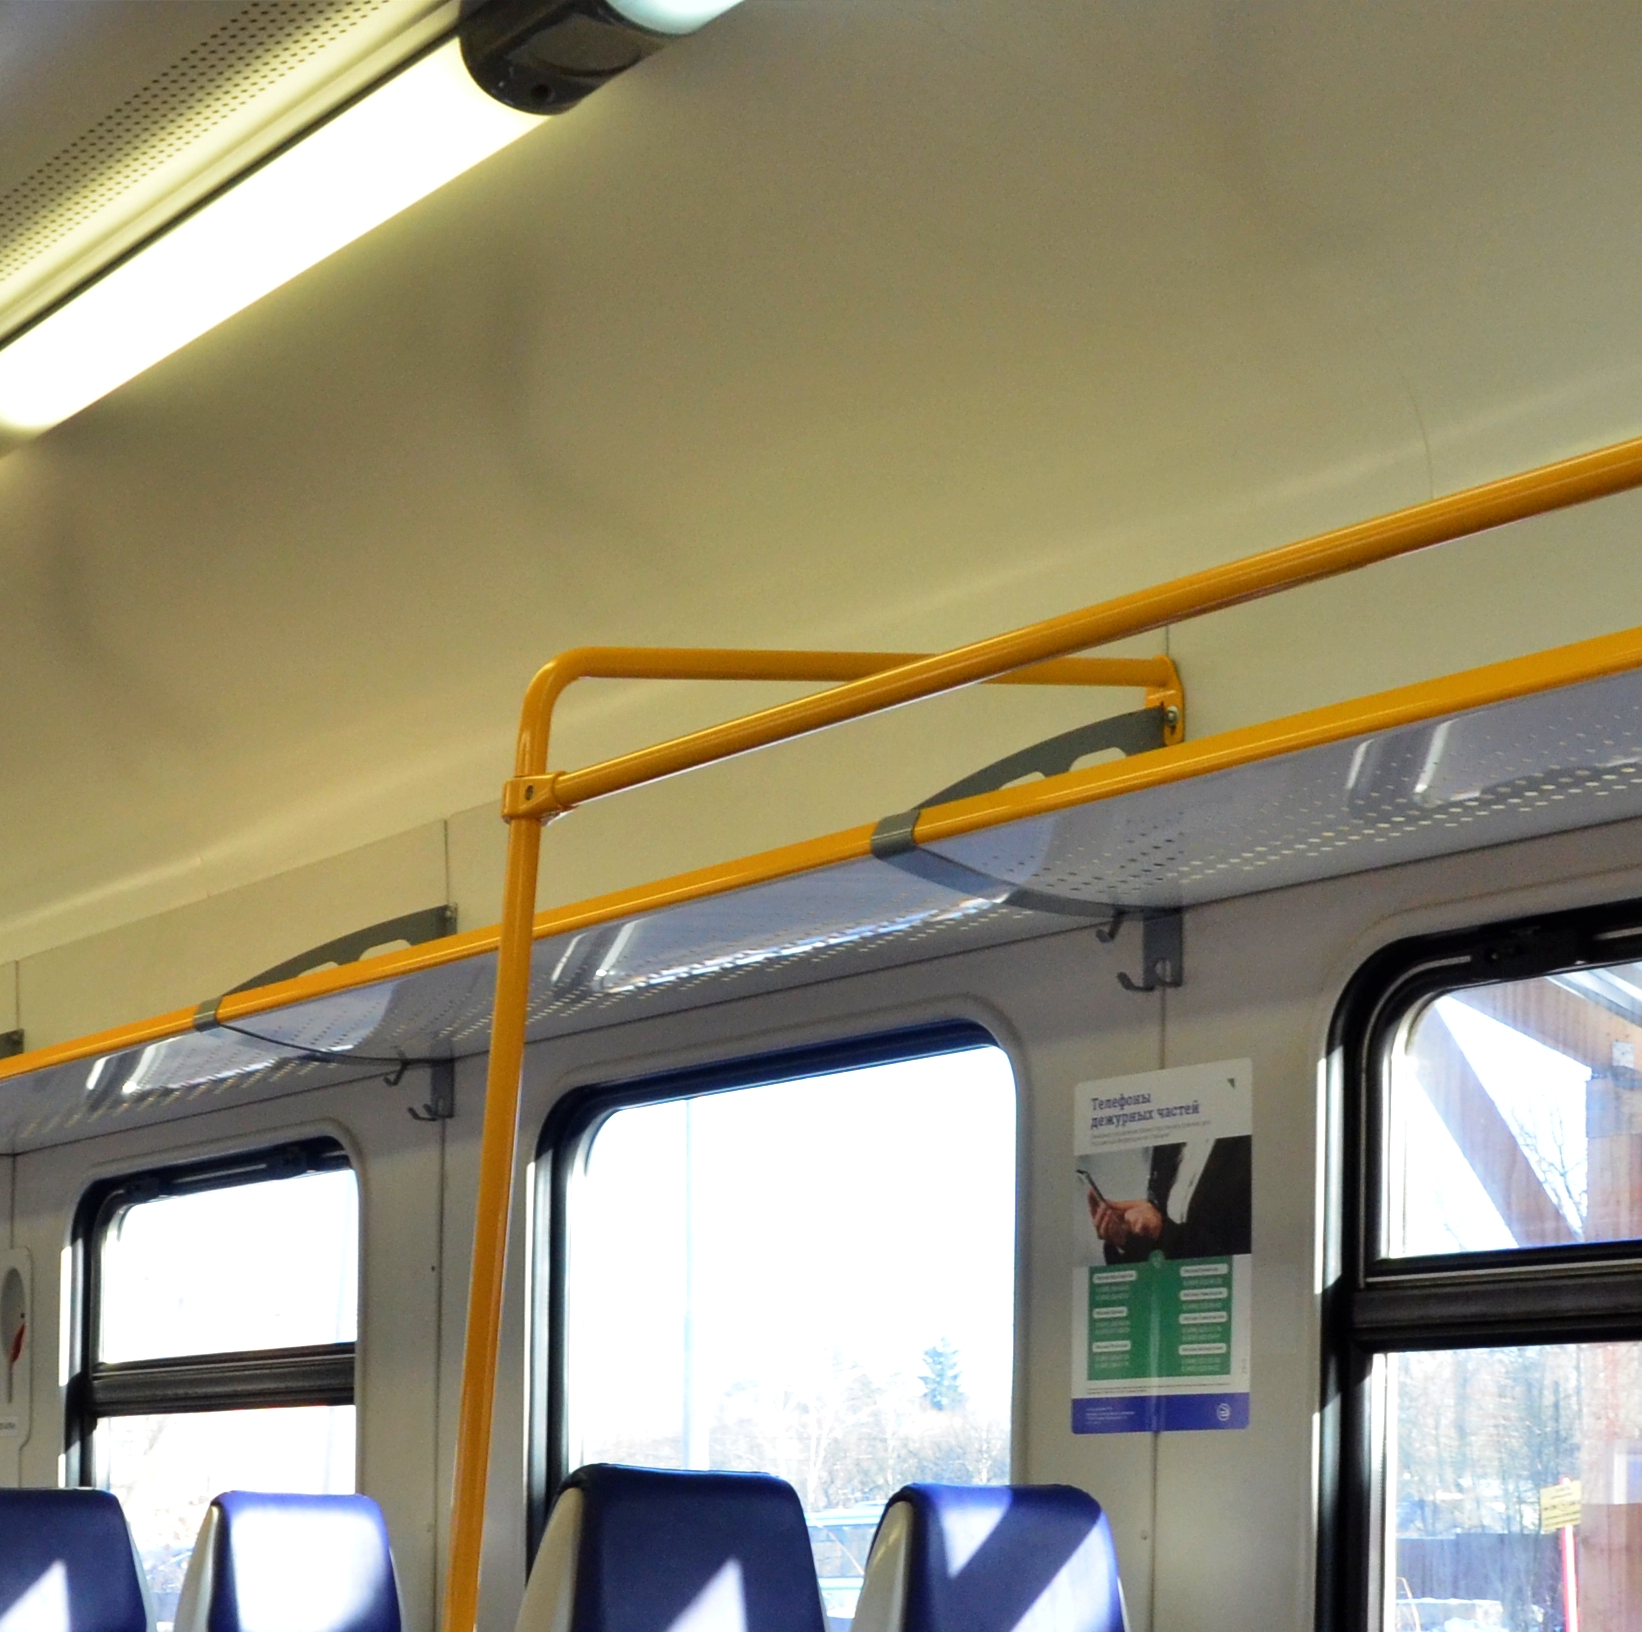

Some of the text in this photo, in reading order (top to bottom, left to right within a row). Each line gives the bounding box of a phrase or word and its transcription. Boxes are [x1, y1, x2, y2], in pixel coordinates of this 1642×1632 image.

[1091, 1093, 1151, 1111] Телефоны
[1090, 1109, 1154, 1130] дежурных
[1157, 1100, 1200, 1119] частей
